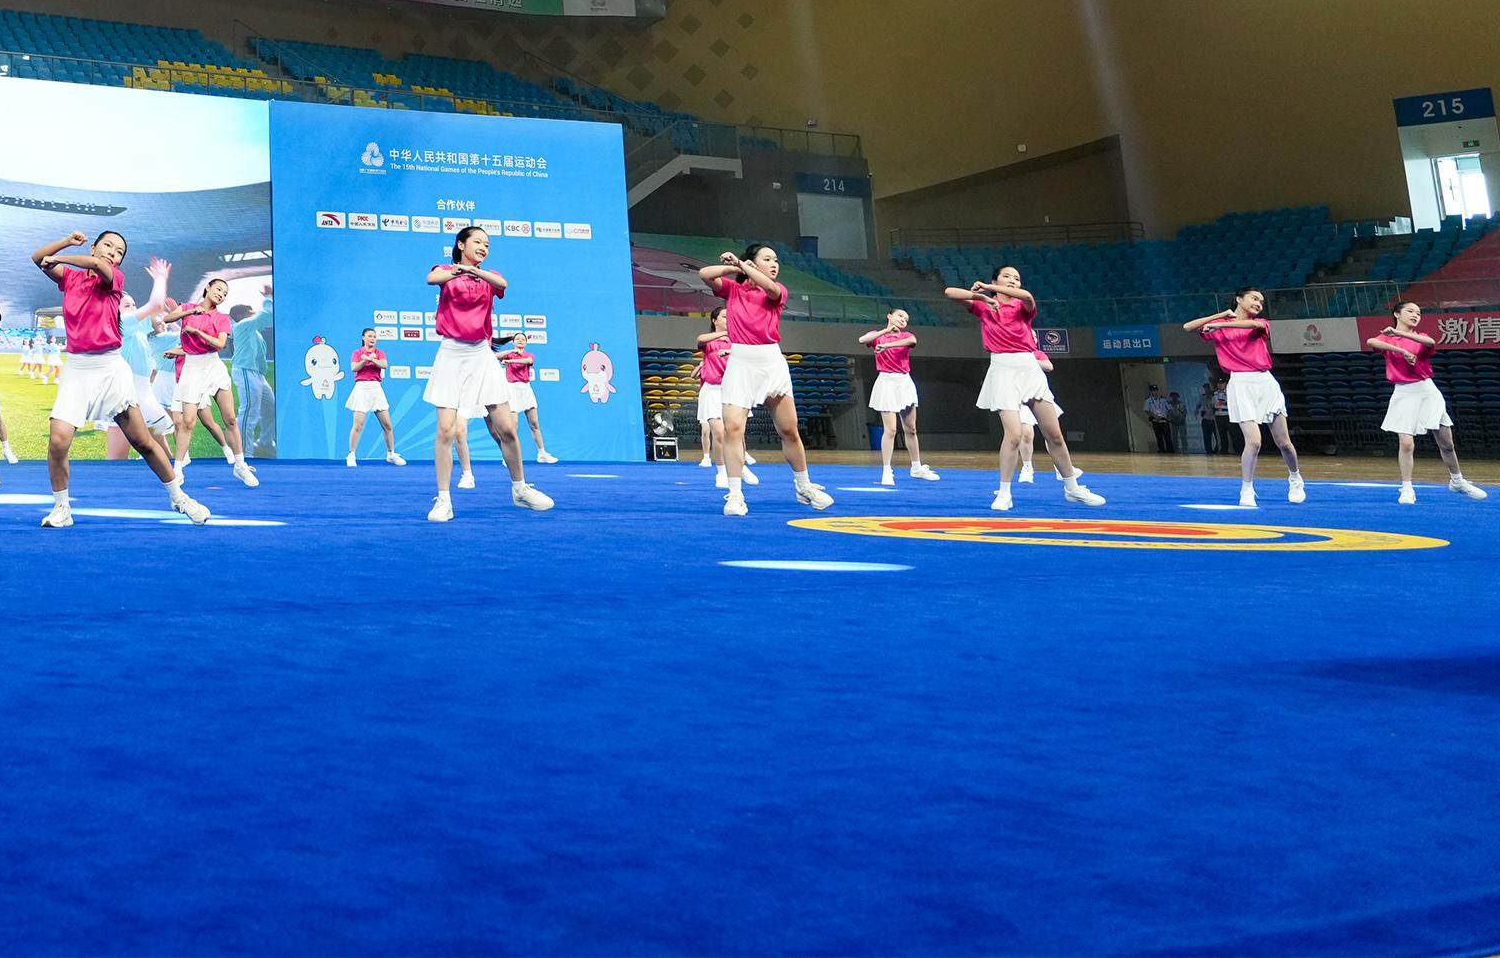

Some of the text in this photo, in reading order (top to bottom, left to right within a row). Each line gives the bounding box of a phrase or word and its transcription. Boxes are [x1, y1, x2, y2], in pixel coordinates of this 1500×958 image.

[1422, 98, 1464, 117] 215
[389, 148, 548, 169] 中华人民共和国第十五届运动会
[390, 162, 401, 170] The
[402, 163, 414, 171] 15th
[416, 164, 440, 172] National
[440, 166, 460, 174] Games
[823, 178, 845, 192] 214
[436, 198, 476, 212] 合作伙伴
[1437, 316, 1500, 344] 激情
[1103, 338, 1152, 350] 运动员出口
